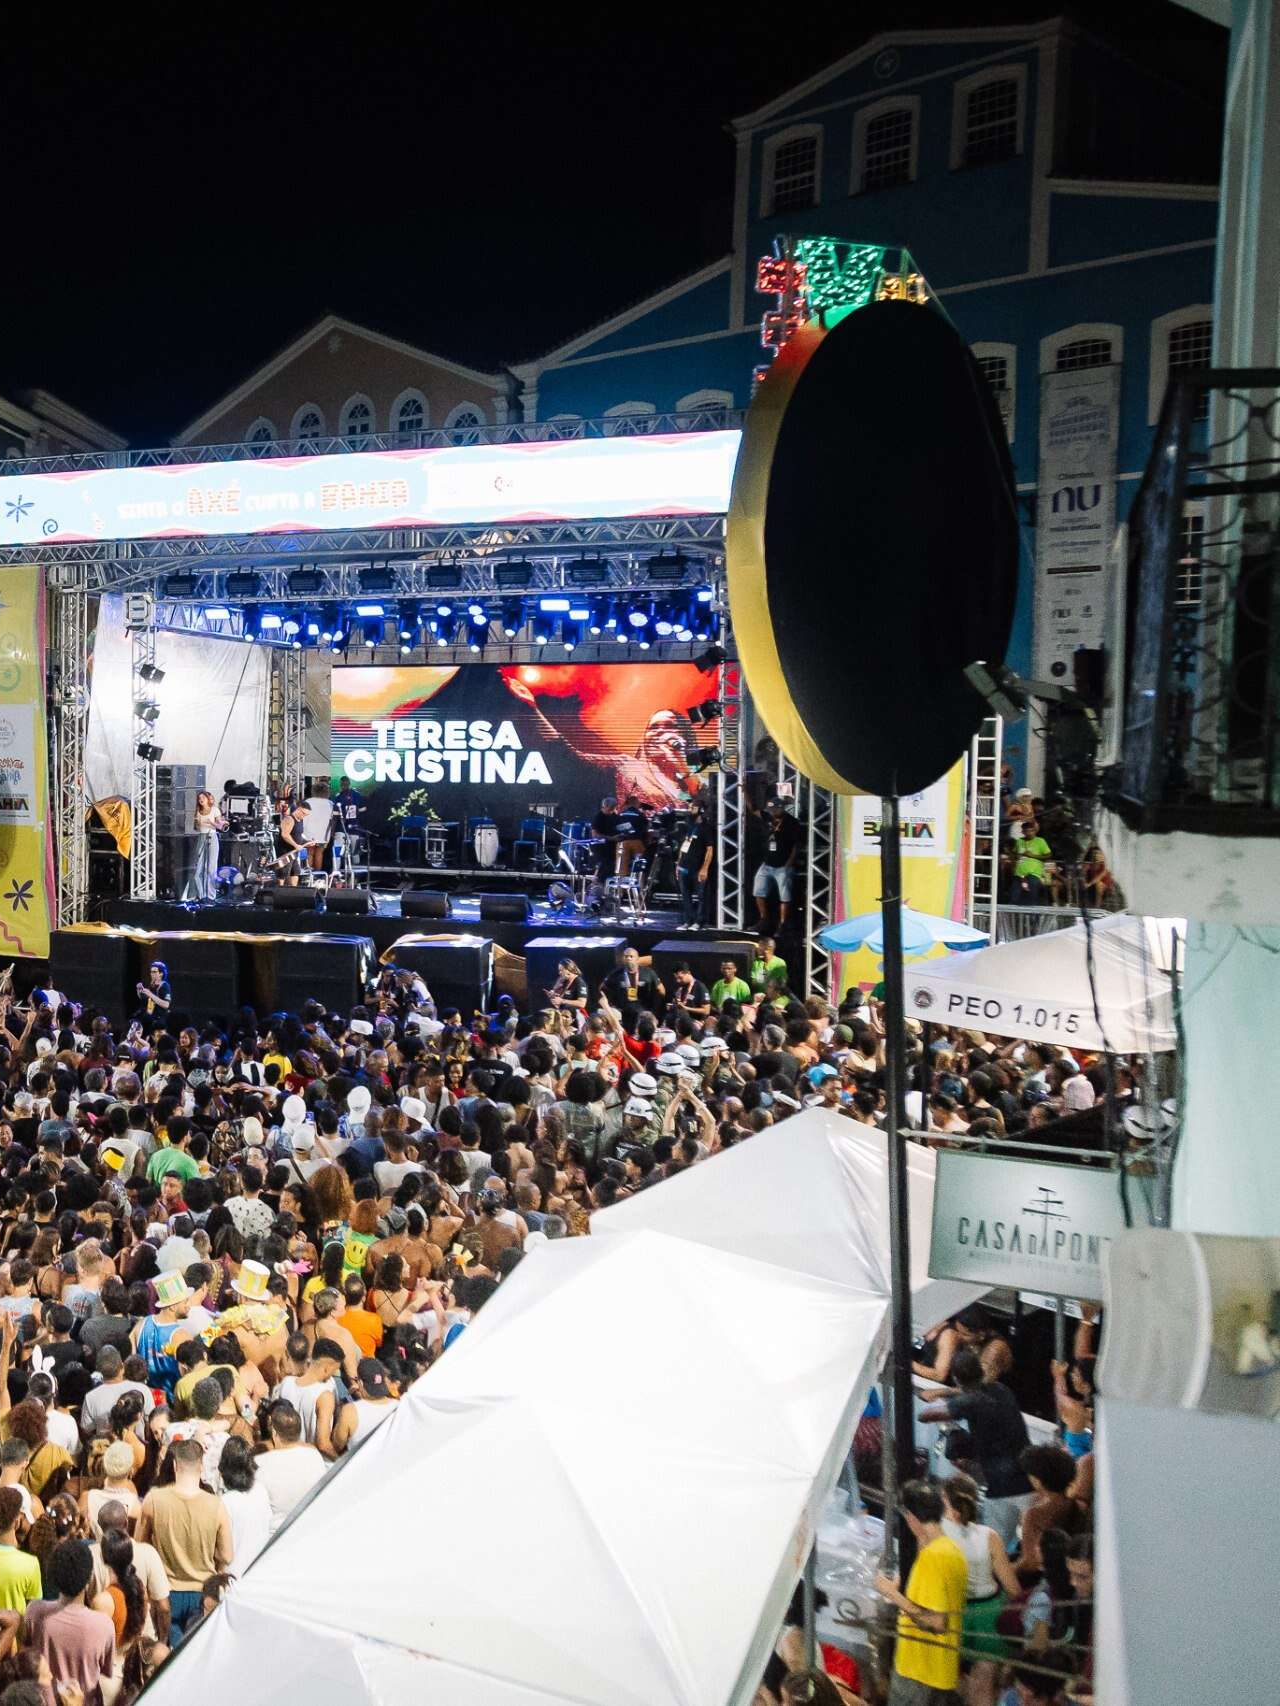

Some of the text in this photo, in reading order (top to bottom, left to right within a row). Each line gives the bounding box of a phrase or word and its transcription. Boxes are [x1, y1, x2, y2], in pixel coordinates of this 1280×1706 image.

[370, 720, 523, 750] TERESA
[343, 749, 553, 784] CRISTINA
[948, 993, 1080, 1034] PEO 1.015
[958, 1217, 1023, 1254] CASA
[1055, 1230, 1111, 1264] PON
